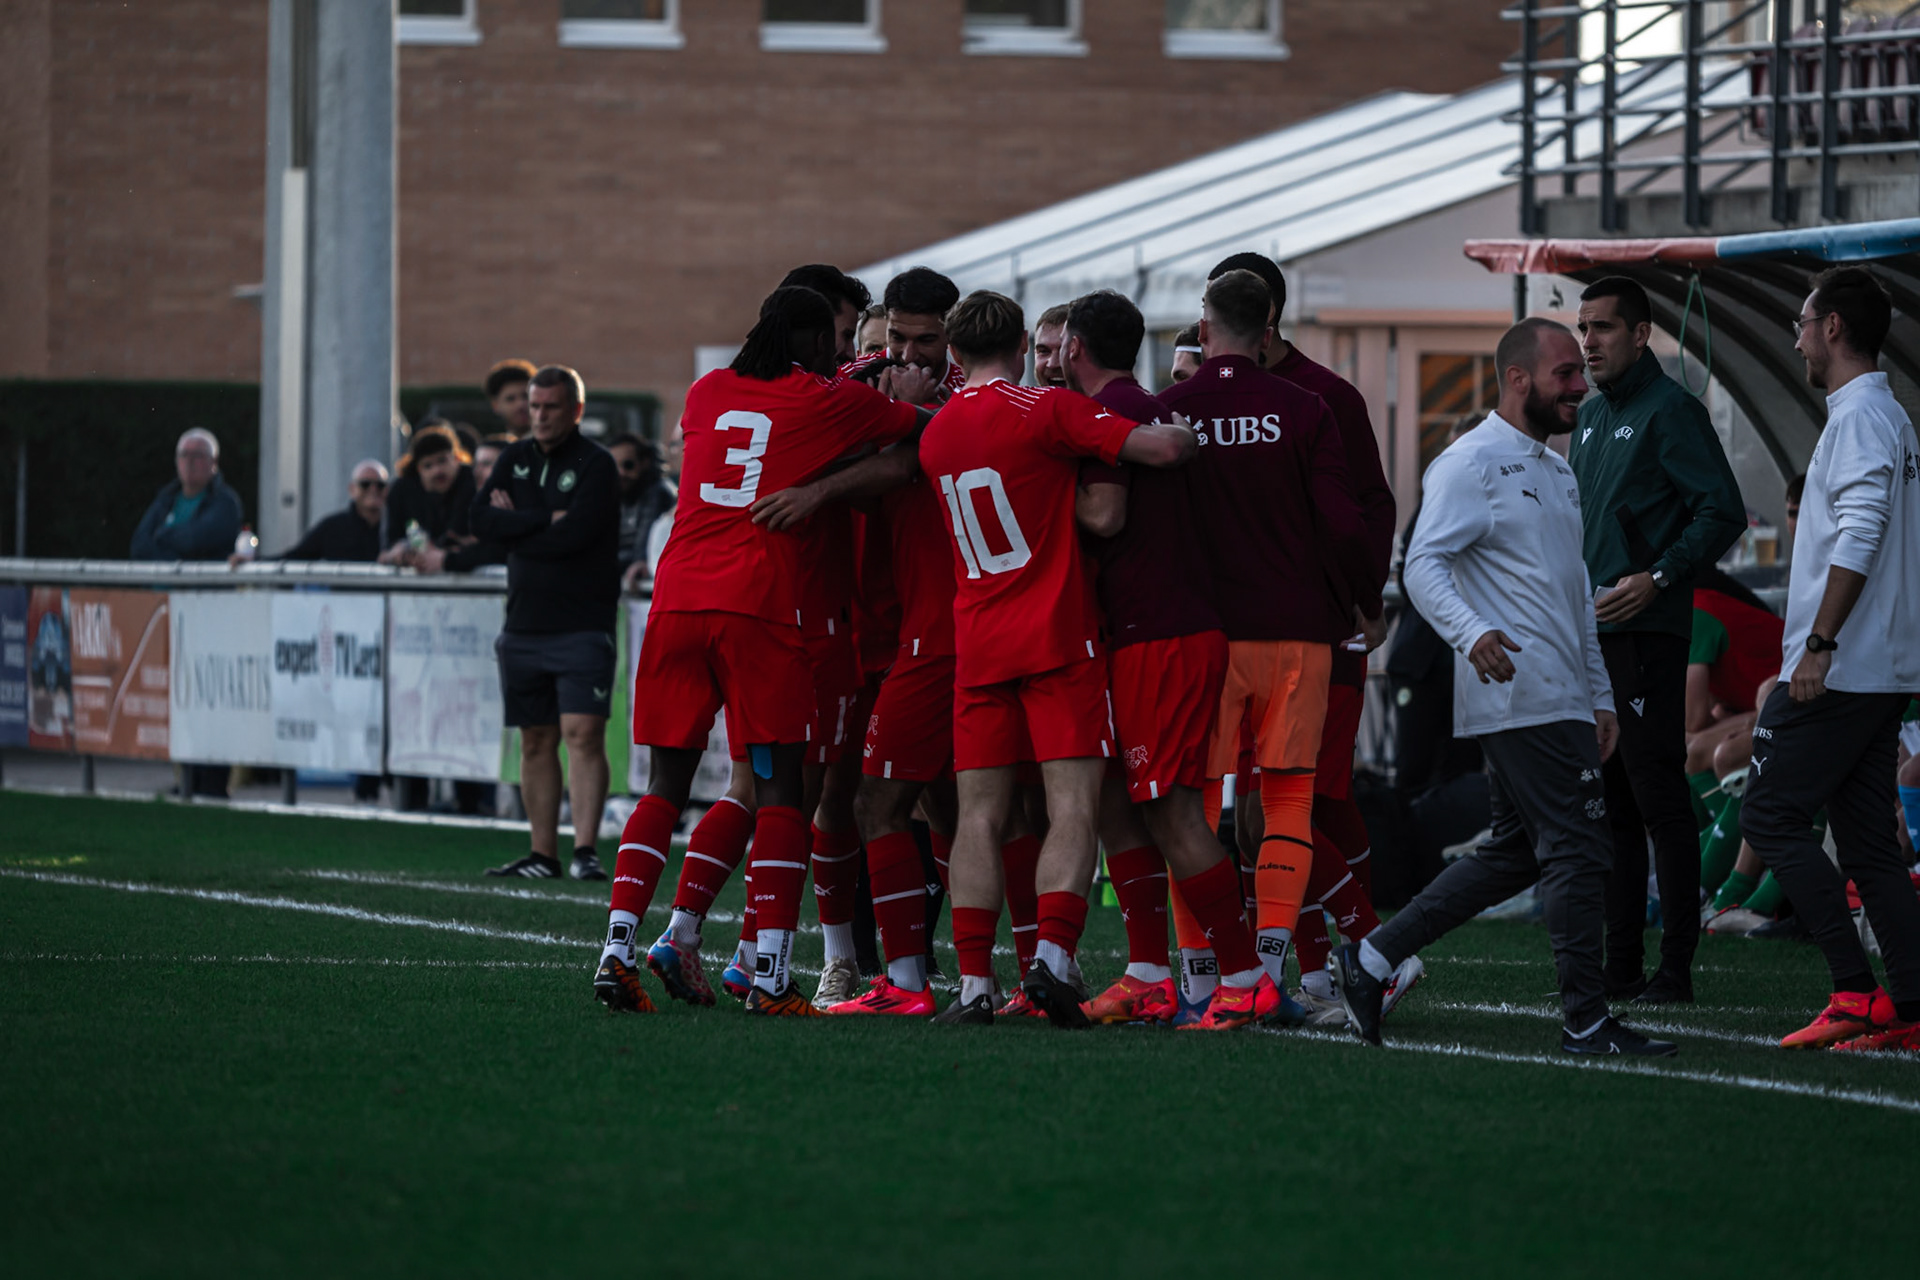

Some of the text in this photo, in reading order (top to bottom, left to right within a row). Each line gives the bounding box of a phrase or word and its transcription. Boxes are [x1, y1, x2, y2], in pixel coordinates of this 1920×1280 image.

[1211, 414, 1281, 446] UBS
[699, 410, 773, 508] 3
[1508, 464, 1526, 474] UBS
[938, 466, 1032, 579] 10
[1260, 937, 1283, 955] FS
[1192, 958, 1217, 975] FS
